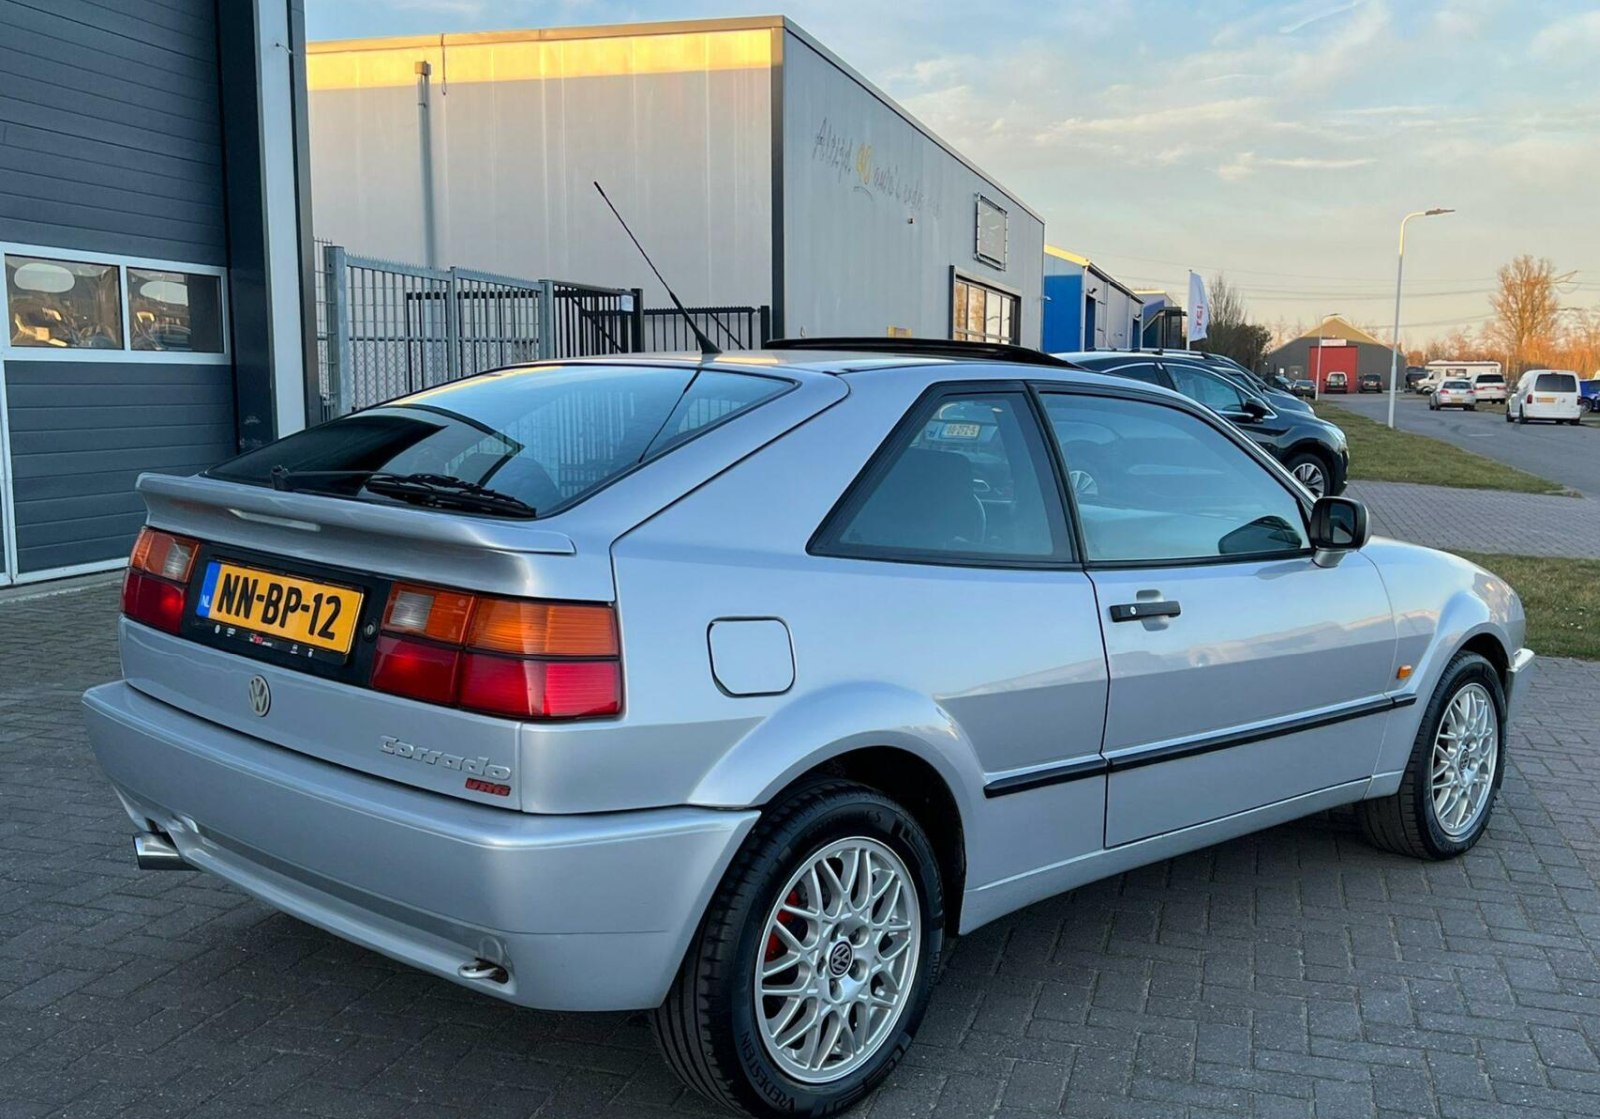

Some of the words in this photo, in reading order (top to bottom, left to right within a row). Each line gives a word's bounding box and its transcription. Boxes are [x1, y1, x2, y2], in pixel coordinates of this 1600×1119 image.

[201, 594, 211, 608] NL
[216, 573, 342, 640] NN-BP-12
[380, 735, 512, 780] Corrado
